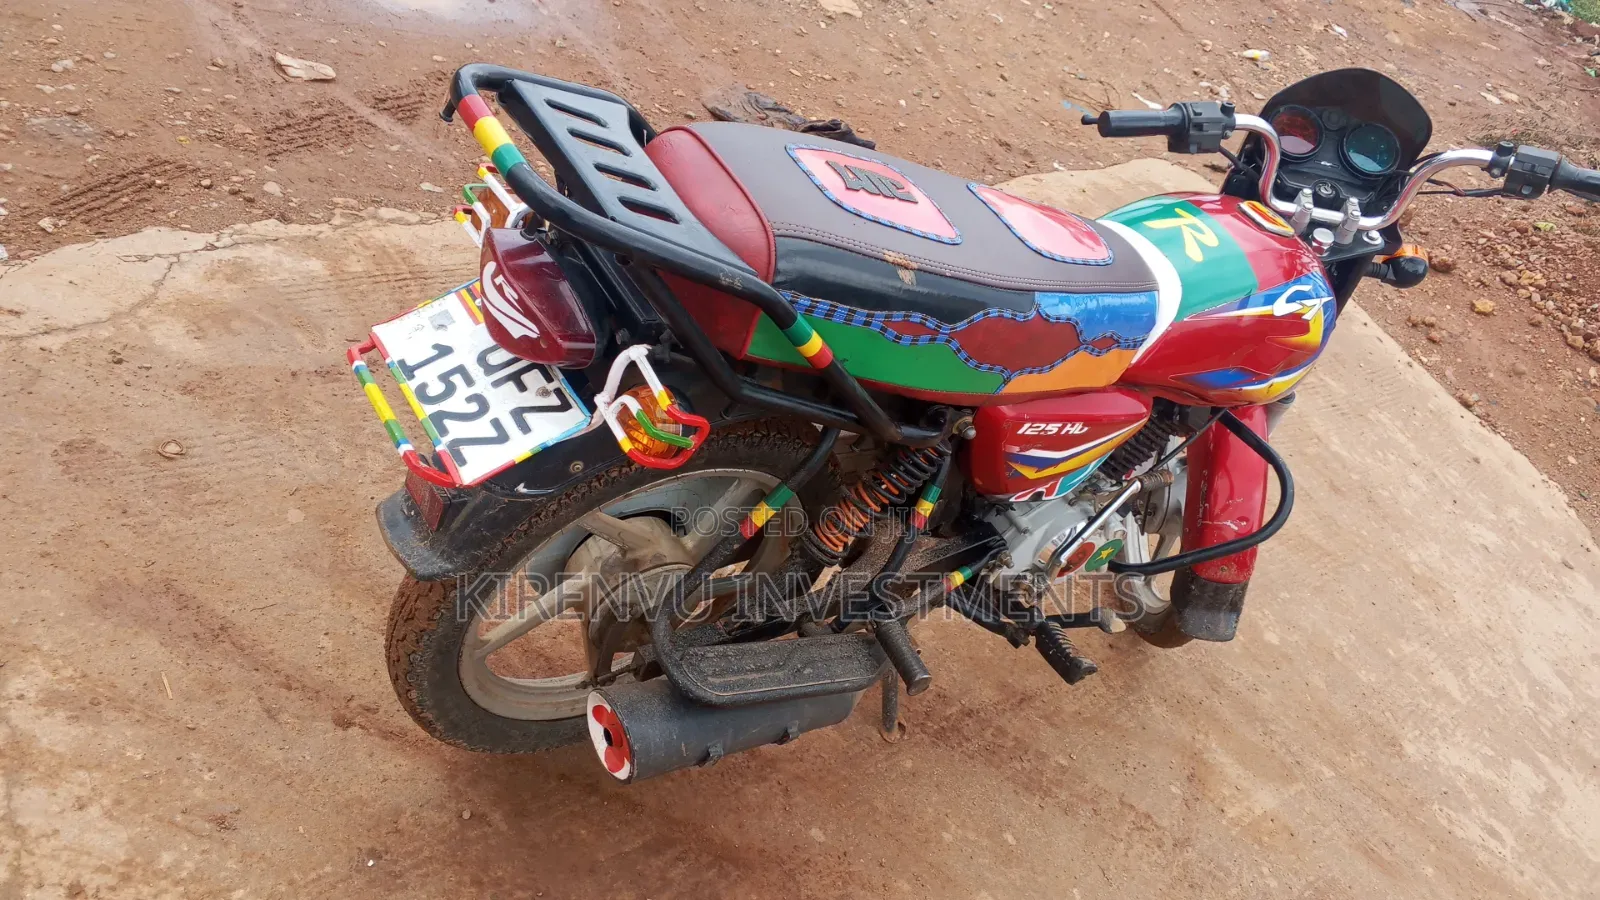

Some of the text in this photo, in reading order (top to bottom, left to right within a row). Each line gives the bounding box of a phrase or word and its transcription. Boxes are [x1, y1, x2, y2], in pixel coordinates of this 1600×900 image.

[1142, 207, 1219, 262] R
[477, 343, 573, 435] UFZ
[1016, 422, 1063, 436] 125
